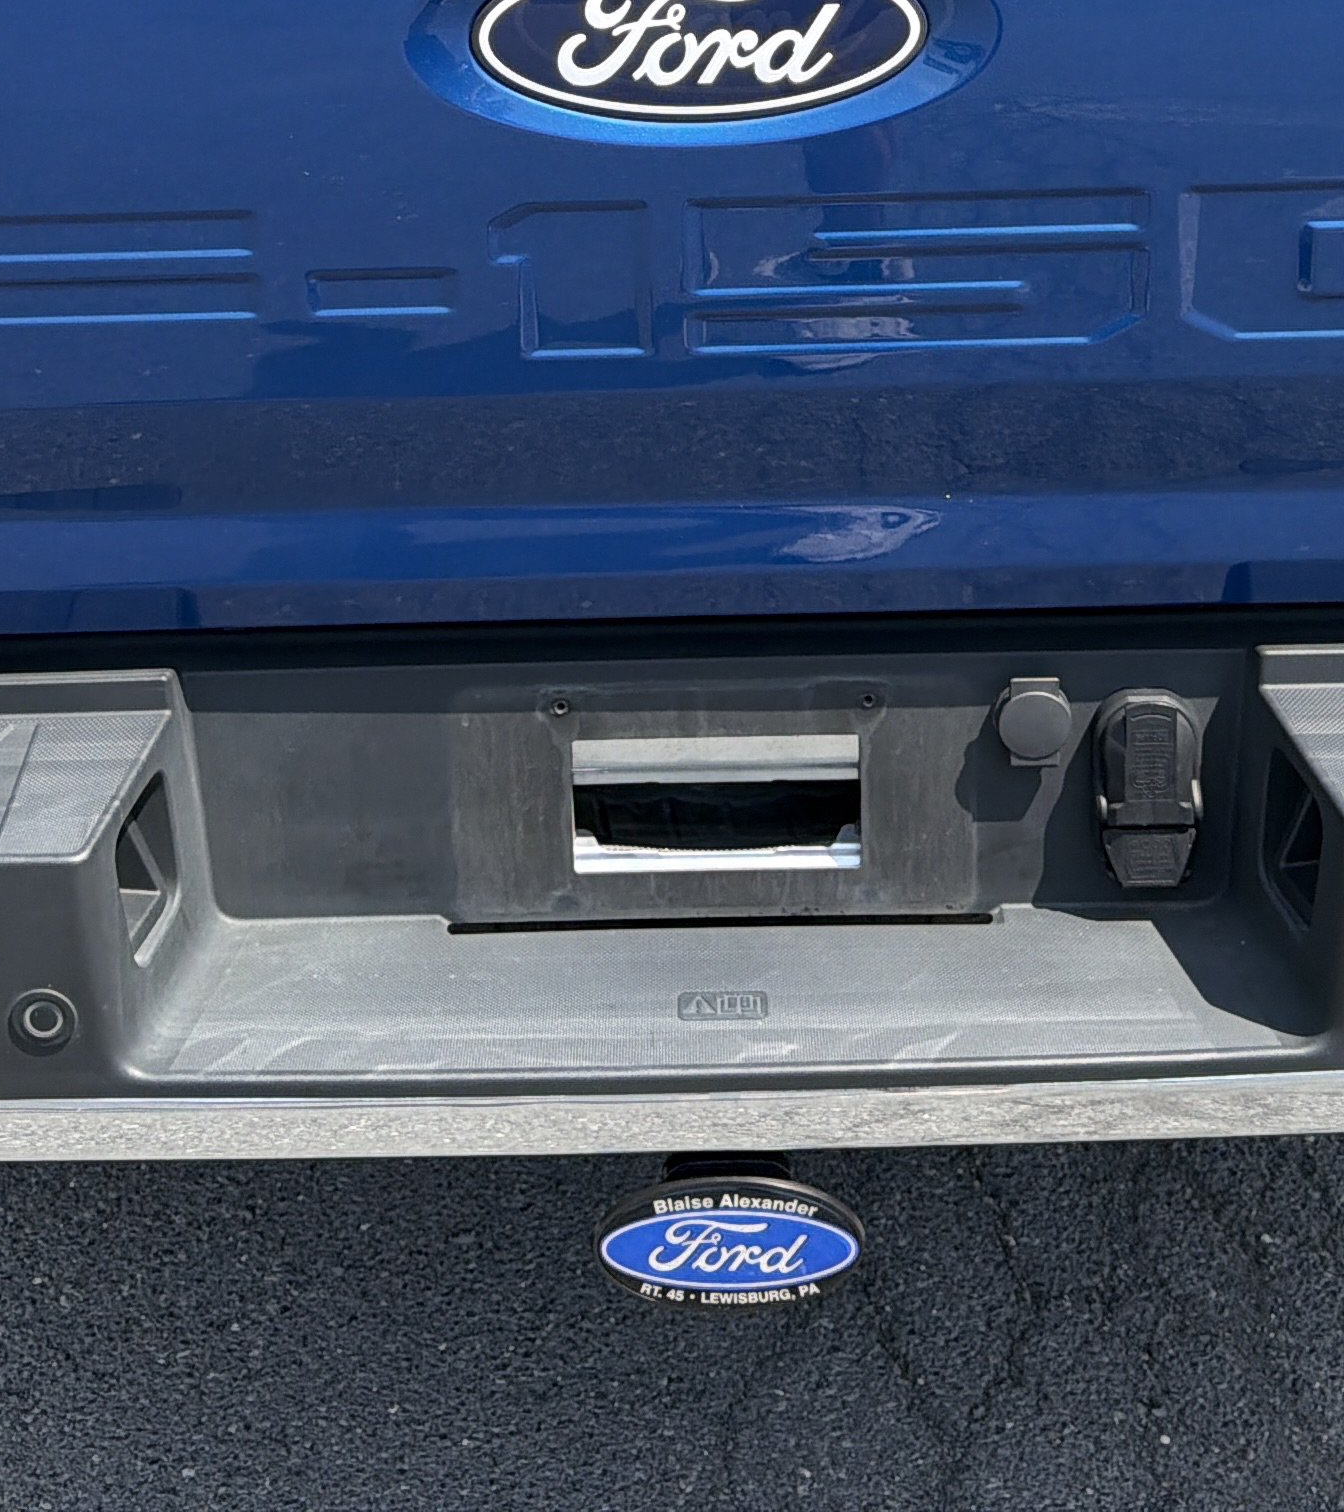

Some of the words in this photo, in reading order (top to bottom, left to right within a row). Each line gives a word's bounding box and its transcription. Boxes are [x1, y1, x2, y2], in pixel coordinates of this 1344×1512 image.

[653, 1195, 713, 1215] Blaise
[719, 1193, 819, 1218] Alexander
[648, 1219, 808, 1273] Ford
[639, 1282, 662, 1299] RT.
[666, 1288, 685, 1302] 45
[700, 1288, 796, 1305] LEWISBURG,
[798, 1282, 821, 1299] PA
